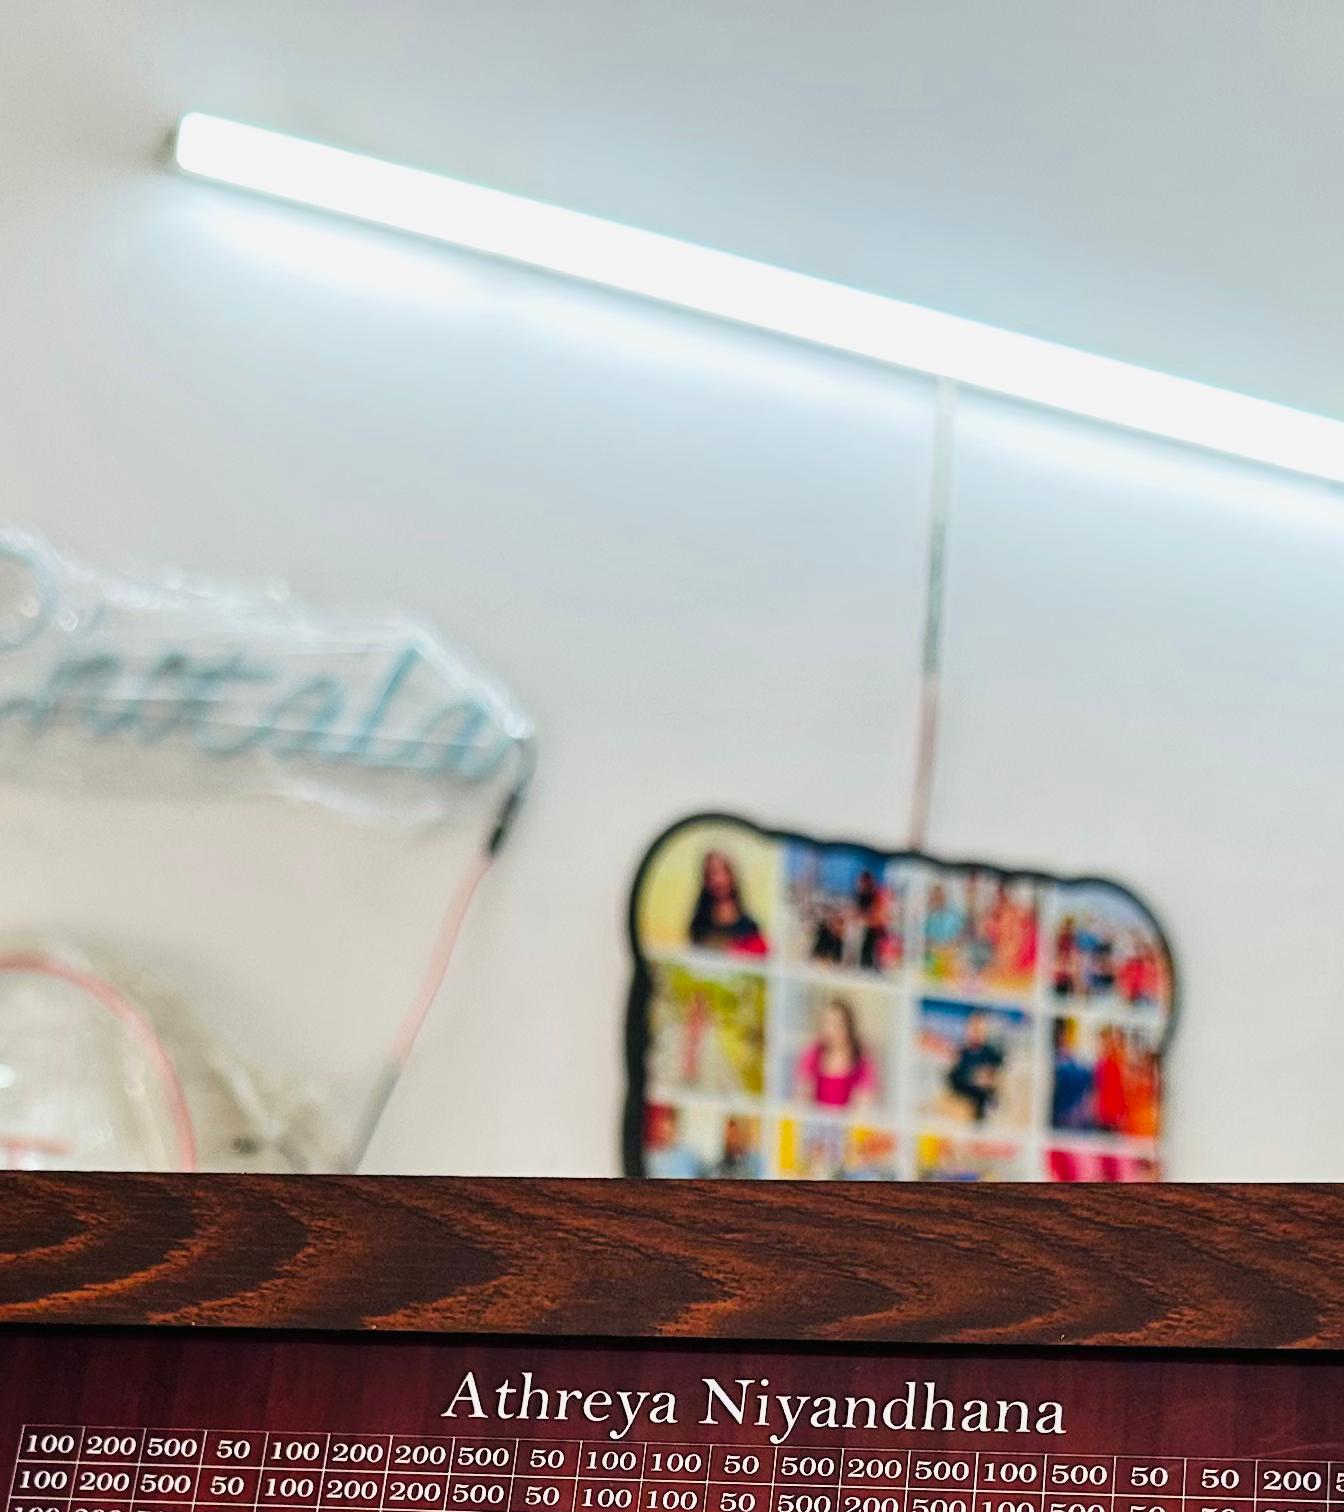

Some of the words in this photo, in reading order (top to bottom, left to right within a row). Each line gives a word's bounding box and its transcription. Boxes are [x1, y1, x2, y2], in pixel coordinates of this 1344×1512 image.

[440, 1371, 678, 1439] Athreya
[698, 1378, 1067, 1445] Niyandhana
[23, 1433, 74, 1454] 100
[86, 1435, 137, 1456] 200
[146, 1437, 198, 1458] 500
[216, 1439, 251, 1459] 50
[271, 1441, 320, 1461] 100
[331, 1442, 384, 1463] 200
[394, 1445, 447, 1465] 200
[457, 1446, 510, 1467] 500
[529, 1449, 565, 1469] 50
[586, 1451, 637, 1471] 100
[650, 1453, 702, 1473] 100
[723, 1454, 760, 1475] 50
[781, 1456, 835, 1477] 500
[847, 1458, 903, 1479] 200
[914, 1460, 970, 1481] 500
[983, 1462, 1037, 1483] 100
[1051, 1464, 1108, 1486] 500
[1130, 1466, 1169, 1488] 50
[1201, 1468, 1240, 1489] 50
[1263, 1470, 1322, 1492] 200
